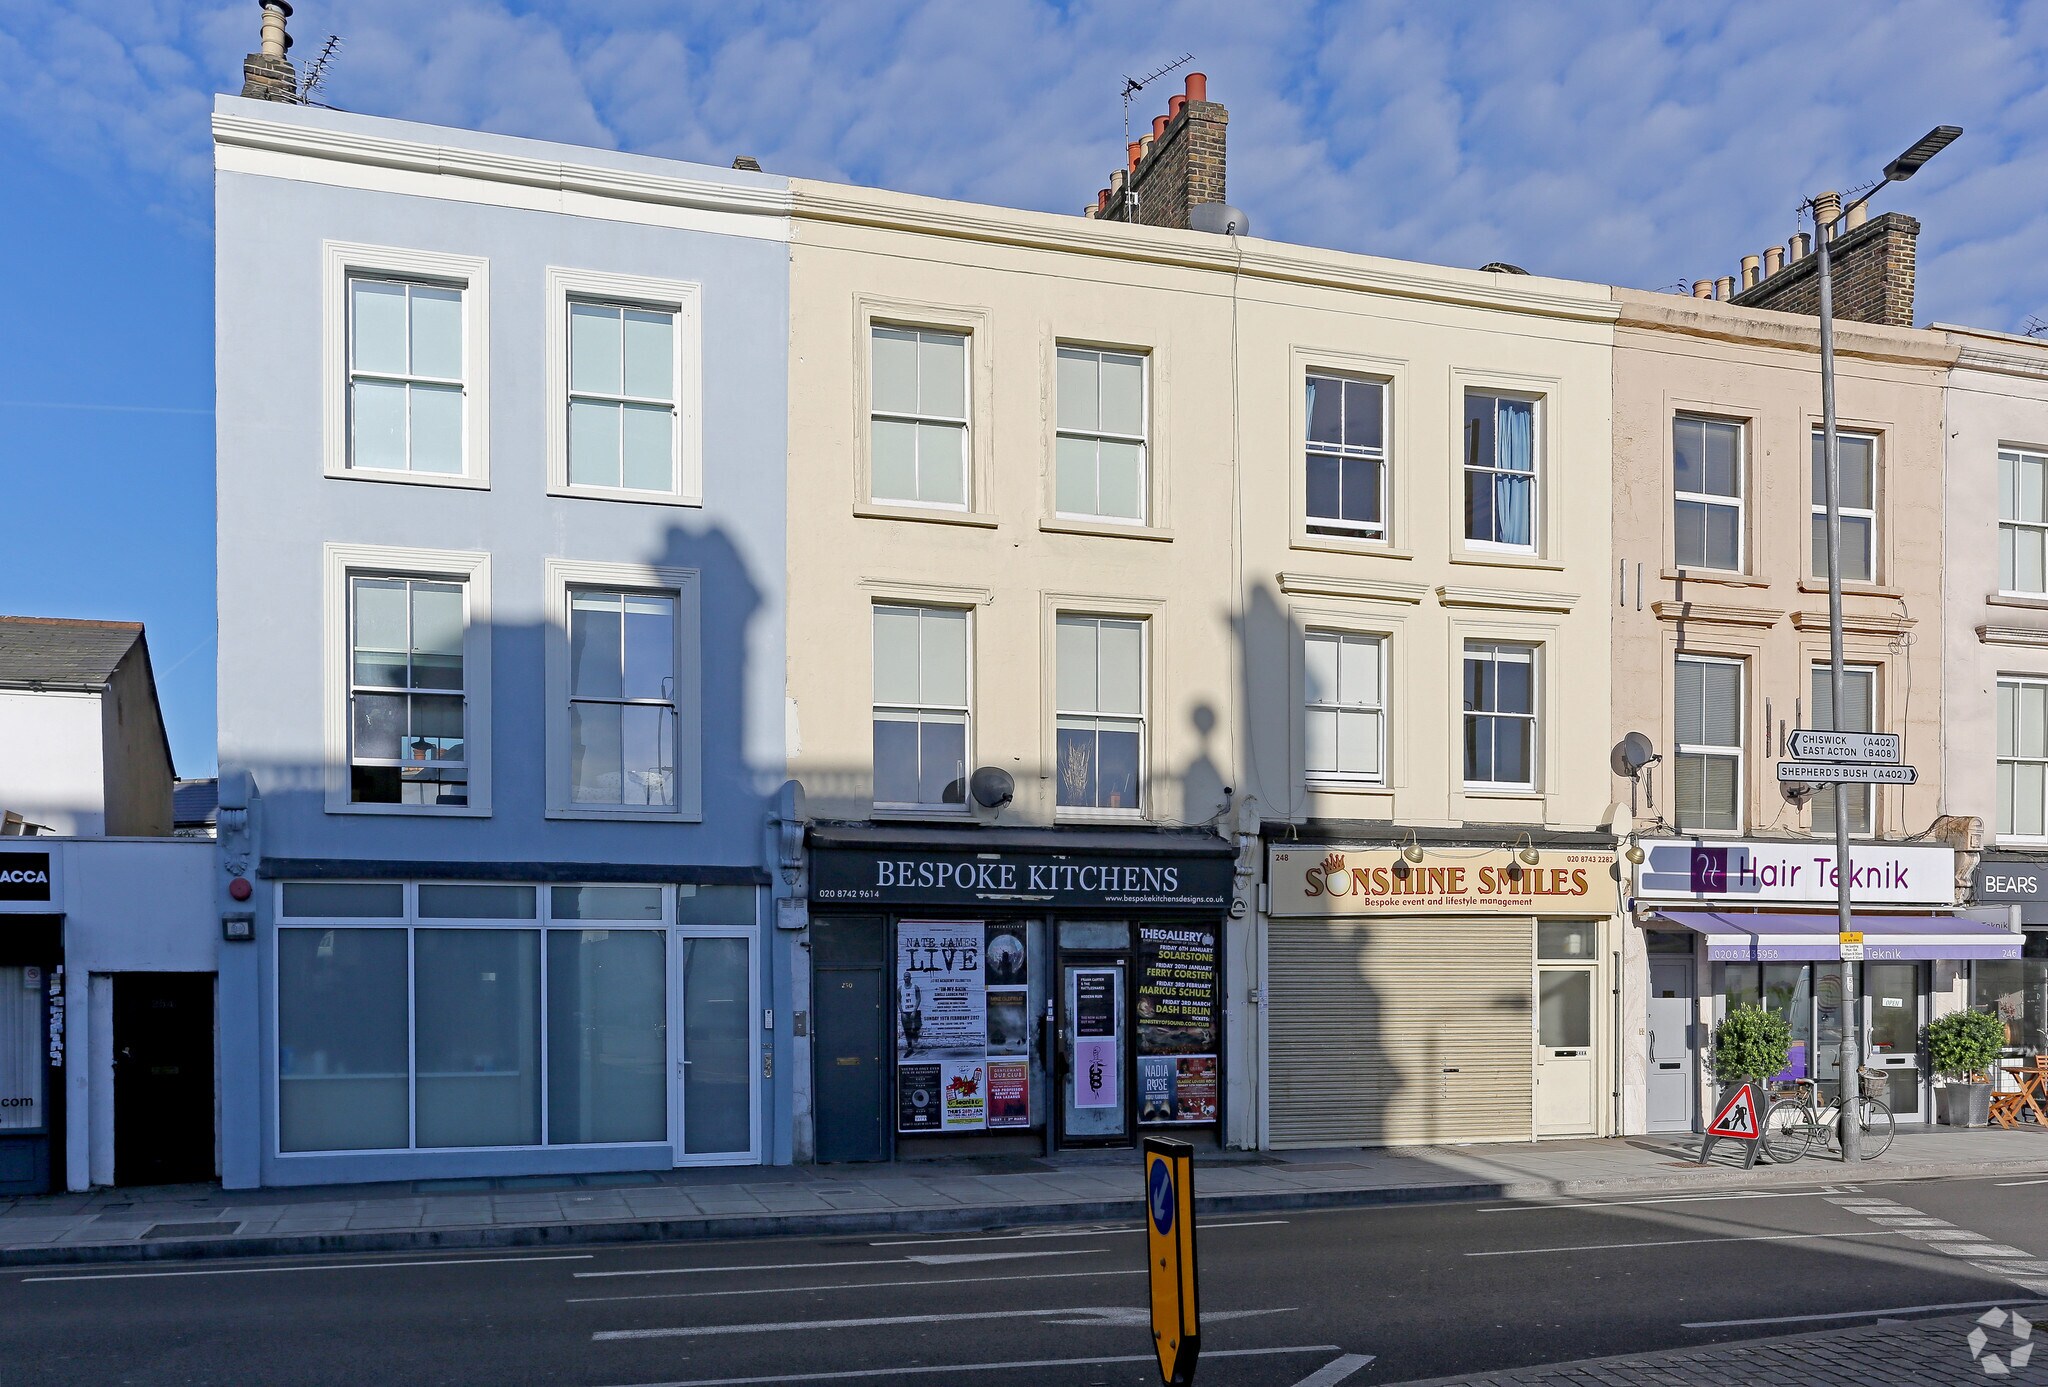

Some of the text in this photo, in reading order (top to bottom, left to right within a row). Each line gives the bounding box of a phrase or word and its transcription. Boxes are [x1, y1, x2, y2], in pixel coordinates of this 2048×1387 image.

[1802, 735, 1895, 748] CHISWICK (A402)
[1802, 746, 1896, 758] EAST ACTON (B408)
[1781, 767, 1907, 780] SHEPHERD'S BUSH (A402)
[1275, 854, 1289, 862] 248
[1567, 855, 1579, 863] 020
[1598, 856, 1613, 864] 2282
[0, 870, 48, 883] ACCA
[876, 860, 1179, 892] BESPOKE KITCHENS
[1739, 855, 1909, 889] Hair Teknik
[1304, 866, 1589, 897] SONSHINE SMILES
[1985, 875, 2038, 894] BEARS
[819, 889, 879, 898] 020 8742 9614
[1105, 894, 1224, 904] www.bespokekitchensdesigns.co.uk
[1364, 896, 1532, 908] Bespoke event and lifestyle management
[1139, 928, 1203, 942] THEGALLERY
[906, 937, 978, 948] NATE JAMES
[1158, 951, 1213, 962] SOLARSTONE
[1714, 949, 1738, 959] 0208
[1866, 947, 1902, 959] Teknik
[2002, 949, 2017, 958] 246
[906, 948, 978, 973] LIVE
[1146, 968, 1212, 980] FERRY CORSTEN
[1139, 986, 1211, 997] MARKUS SCHULZ
[1885, 999, 1900, 1007] OPEN
[1156, 1005, 1210, 1015] DASH BERLIN
[1145, 1064, 1169, 1077] NADIA
[1146, 1078, 1168, 1091] ROSE
[1, 1098, 33, 1107] com
